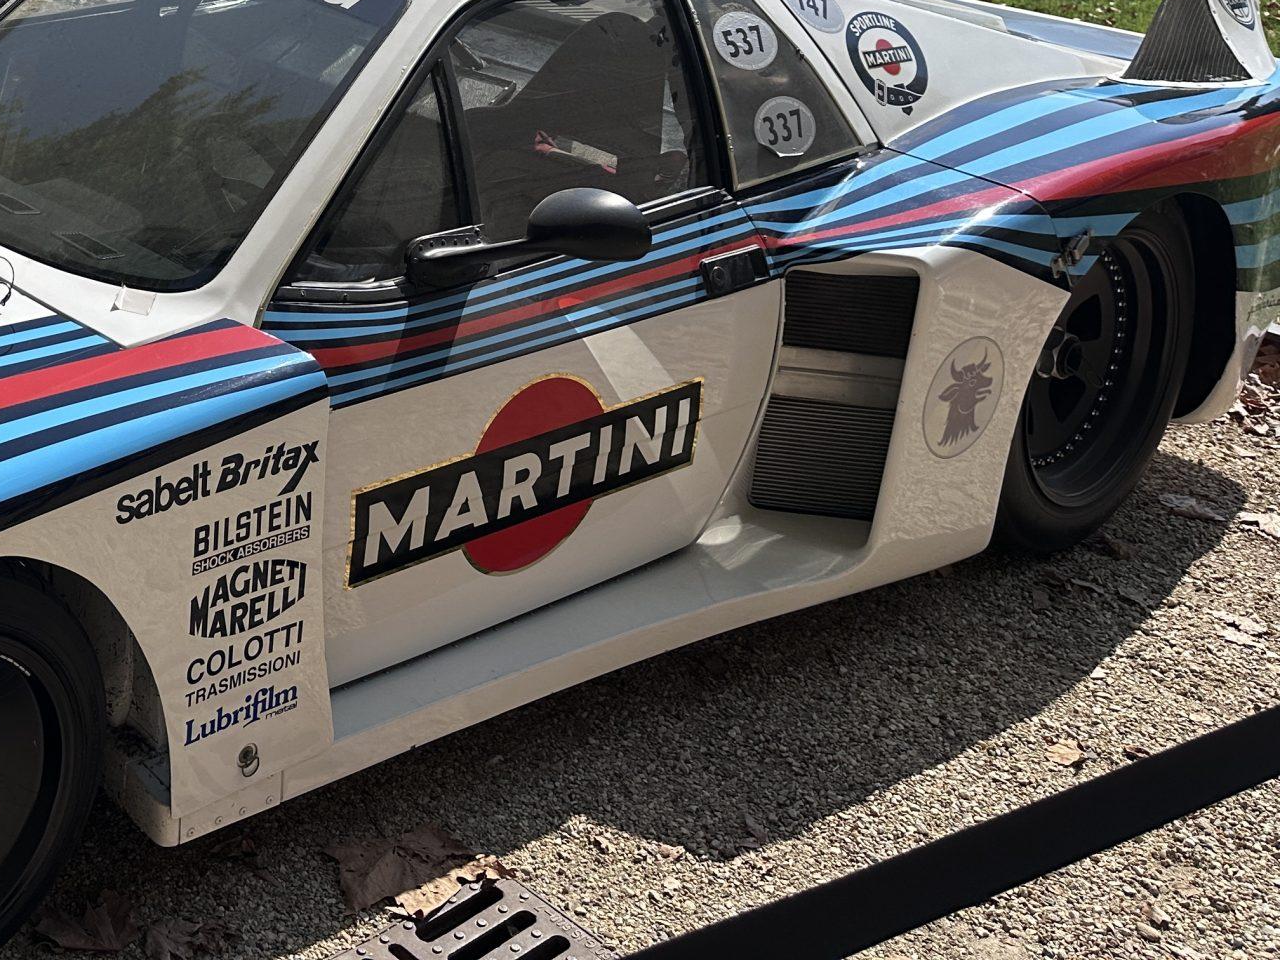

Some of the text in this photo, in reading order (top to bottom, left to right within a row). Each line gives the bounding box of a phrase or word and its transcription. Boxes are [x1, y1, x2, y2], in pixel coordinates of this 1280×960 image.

[721, 24, 765, 58] 537
[849, 13, 897, 37] SPORTLINE
[865, 48, 912, 66] MARTINI
[763, 109, 803, 146] 337
[115, 440, 320, 525] sabelt Britax
[363, 397, 692, 568] MARTINI
[192, 527, 310, 575] SHOCK ABSORBERS
[193, 491, 312, 558] BILSTEIN
[189, 586, 307, 638] MARELLI
[190, 559, 307, 617] MAGNETI
[185, 651, 301, 708] TRASMISSIONI
[186, 620, 304, 685] COLOTTI
[184, 685, 298, 746] Lubrifilm
[265, 701, 298, 720] metal
